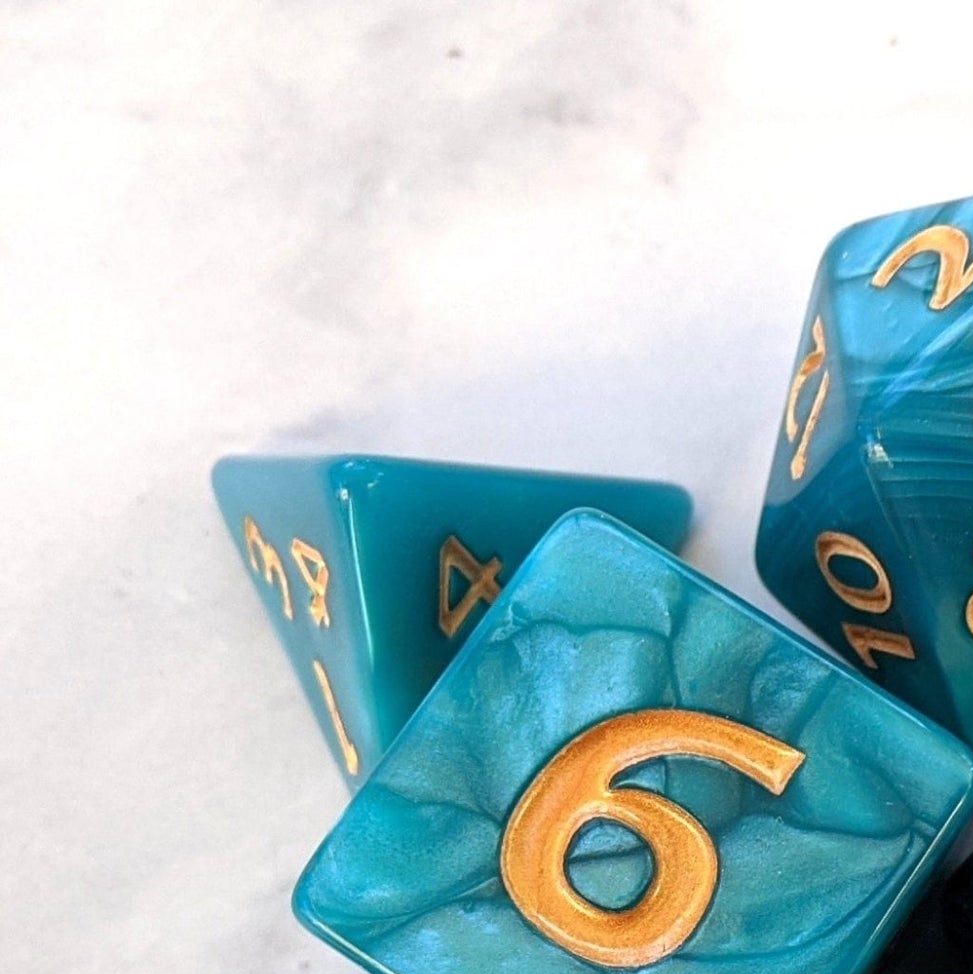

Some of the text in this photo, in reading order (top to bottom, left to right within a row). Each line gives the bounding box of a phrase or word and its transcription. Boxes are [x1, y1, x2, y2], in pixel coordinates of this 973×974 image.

[438, 534, 503, 637] 4
[815, 530, 916, 670] 10
[500, 708, 806, 969] 6
